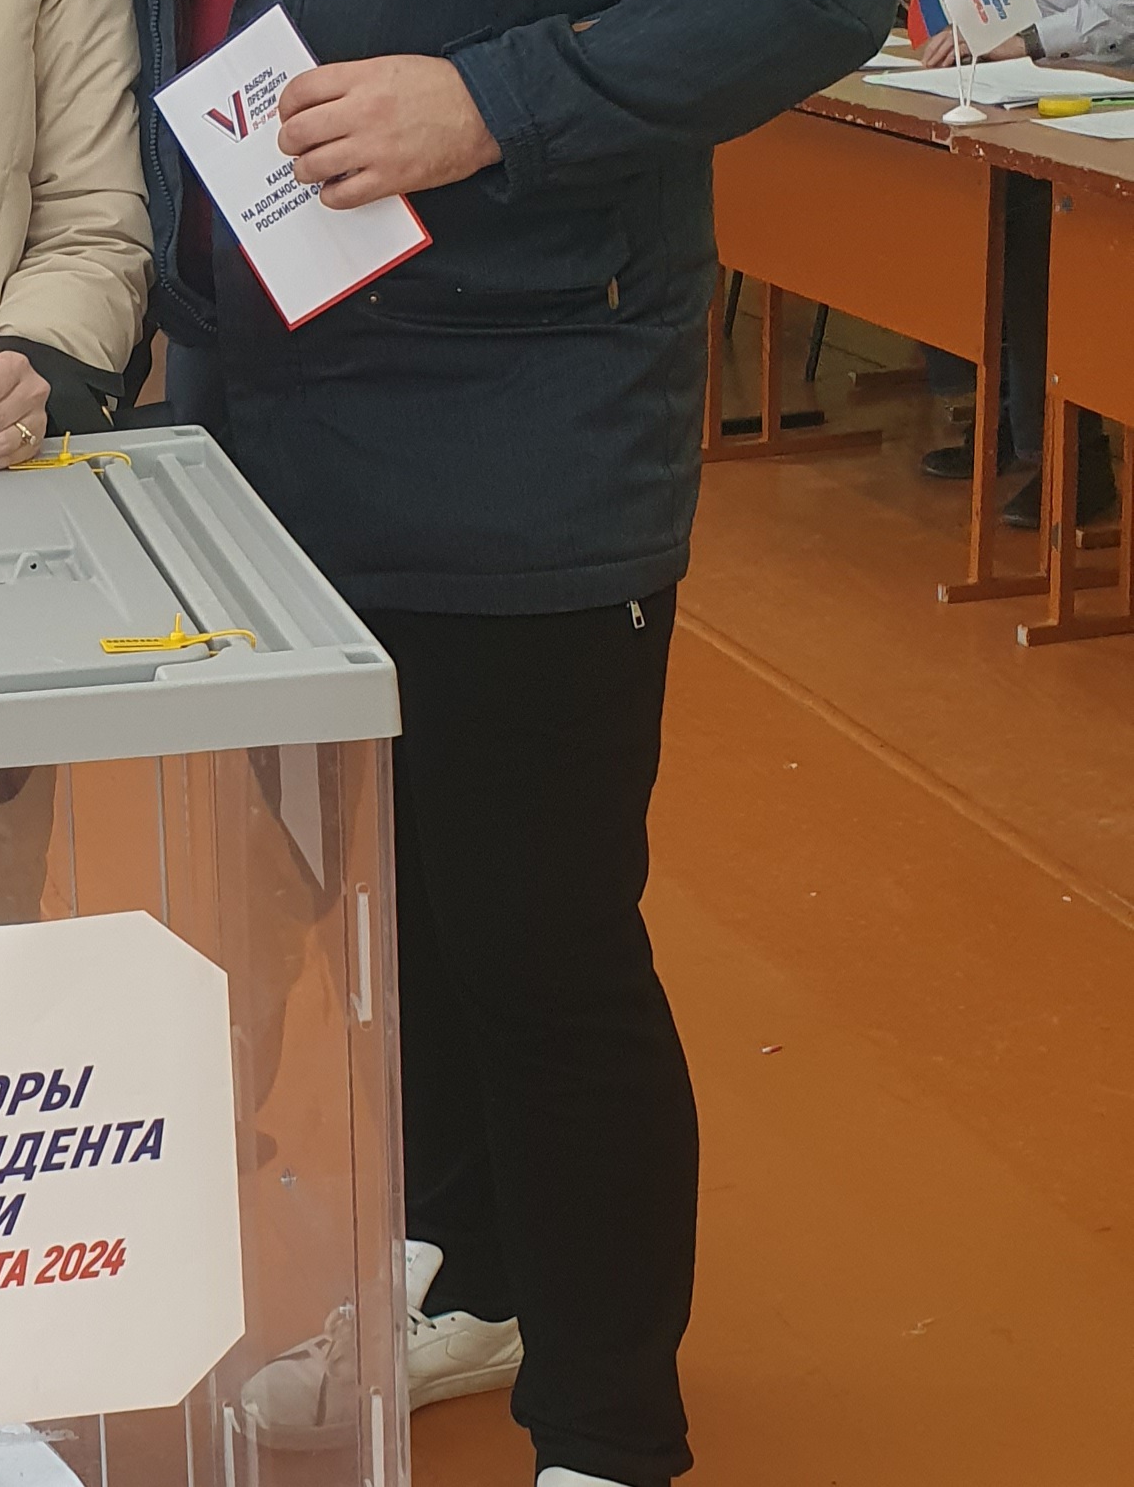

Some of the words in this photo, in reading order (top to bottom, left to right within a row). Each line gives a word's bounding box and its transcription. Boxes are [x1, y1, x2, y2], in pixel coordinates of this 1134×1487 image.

[244, 66, 274, 95] ВЫБОРЫ
[247, 71, 288, 107] ПРЕЗИДЕНТА
[249, 93, 277, 120] РОССИИ
[240, 207, 256, 222] НА
[255, 188, 312, 233] РОССИЙСКОЙ
[33, 1238, 127, 1286] 2024
